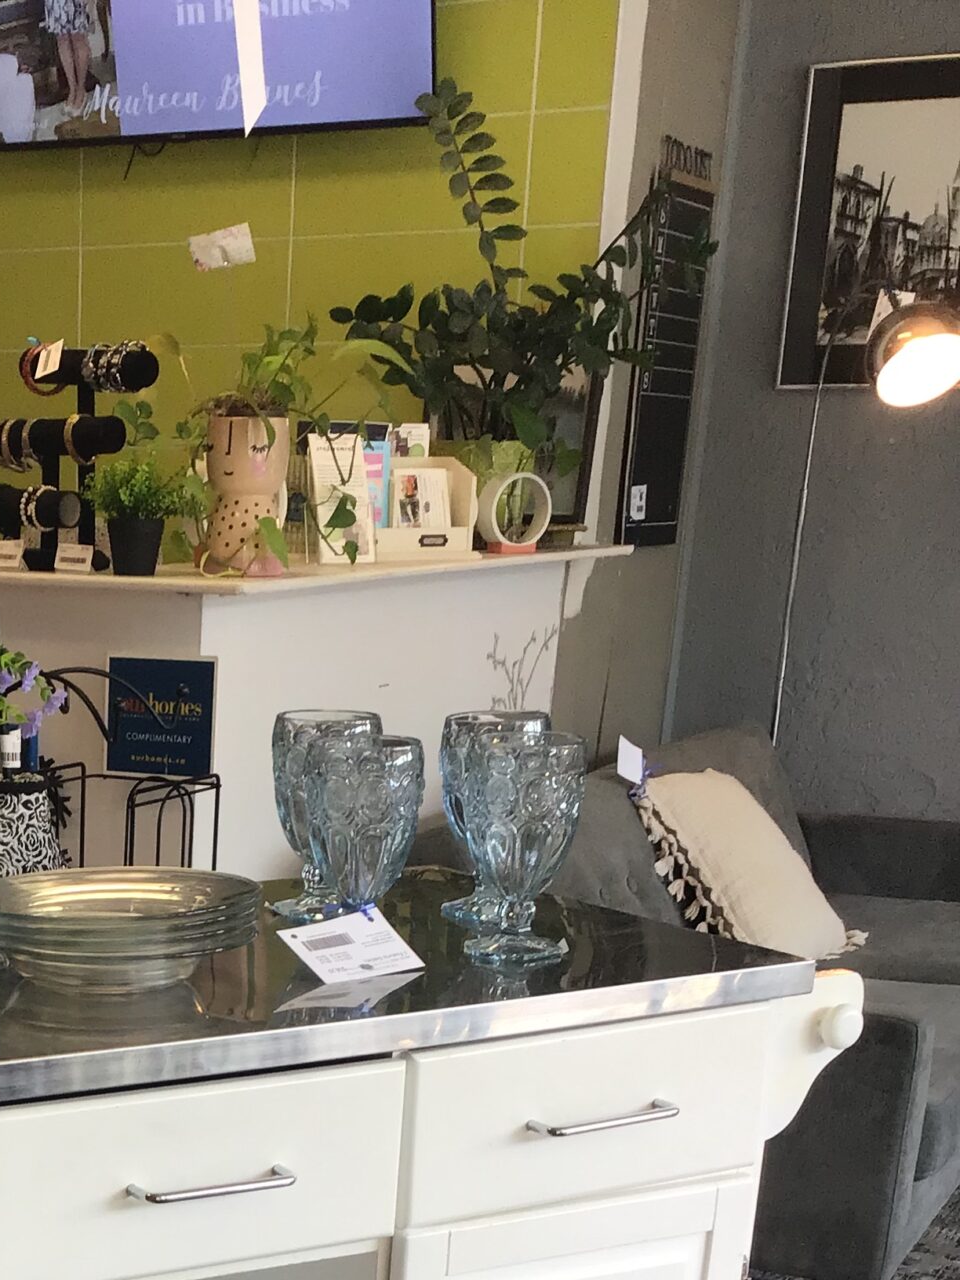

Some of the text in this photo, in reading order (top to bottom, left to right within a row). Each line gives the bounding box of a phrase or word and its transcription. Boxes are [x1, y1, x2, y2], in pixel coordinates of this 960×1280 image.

[214, 0, 350, 23] Bsiness
[83, 80, 207, 123] Maureen
[126, 731, 193, 744] COMPLIMENTARY
